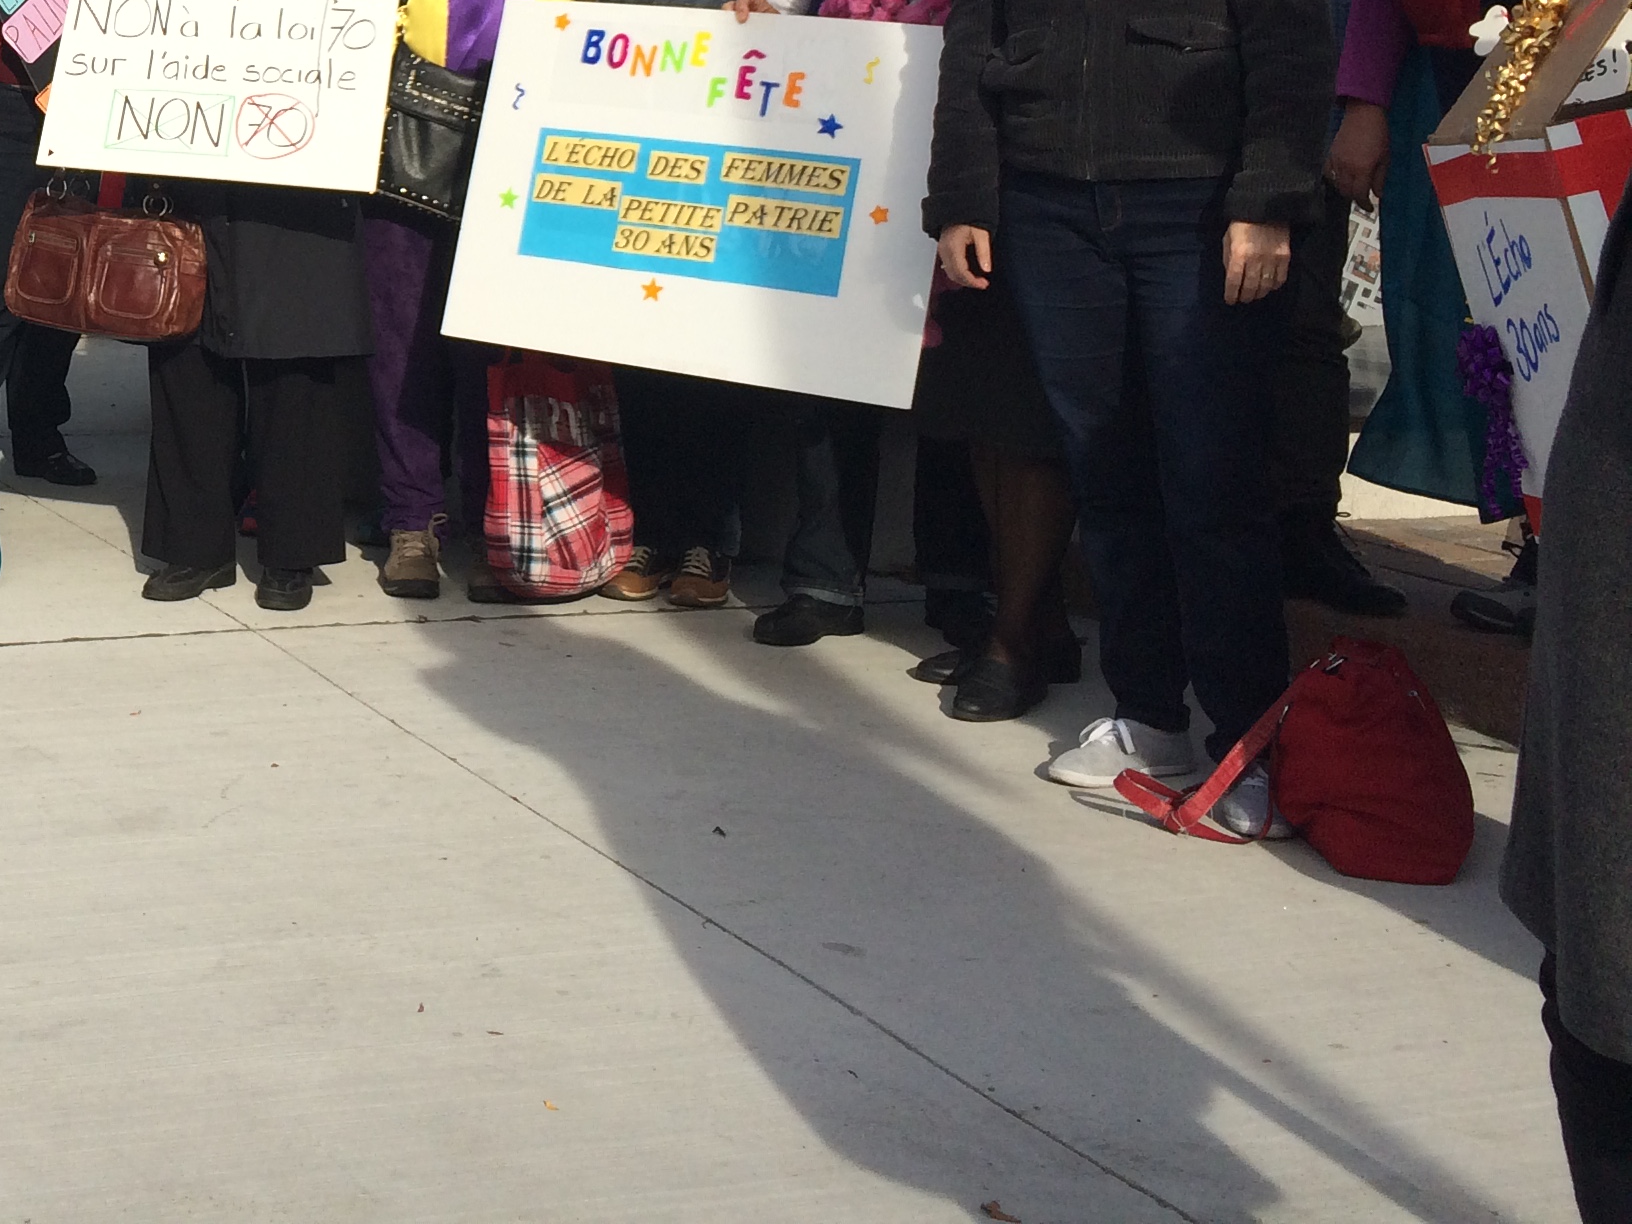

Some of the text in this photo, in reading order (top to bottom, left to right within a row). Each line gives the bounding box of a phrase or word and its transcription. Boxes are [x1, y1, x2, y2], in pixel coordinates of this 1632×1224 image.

[180, 5, 199, 38] à
[231, 5, 261, 40] la
[278, 7, 315, 40] loi
[328, 8, 376, 52] 70
[581, 29, 712, 77] BONNE
[65, 49, 356, 90] sur l'aide sociale
[706, 49, 806, 117] FÊTE
[118, 95, 225, 148] NON
[545, 138, 847, 191] L'ÉCHO DES FEMMES
[535, 179, 841, 234] DE LA PETITE PATRIE
[614, 229, 715, 259] 30 ANS
